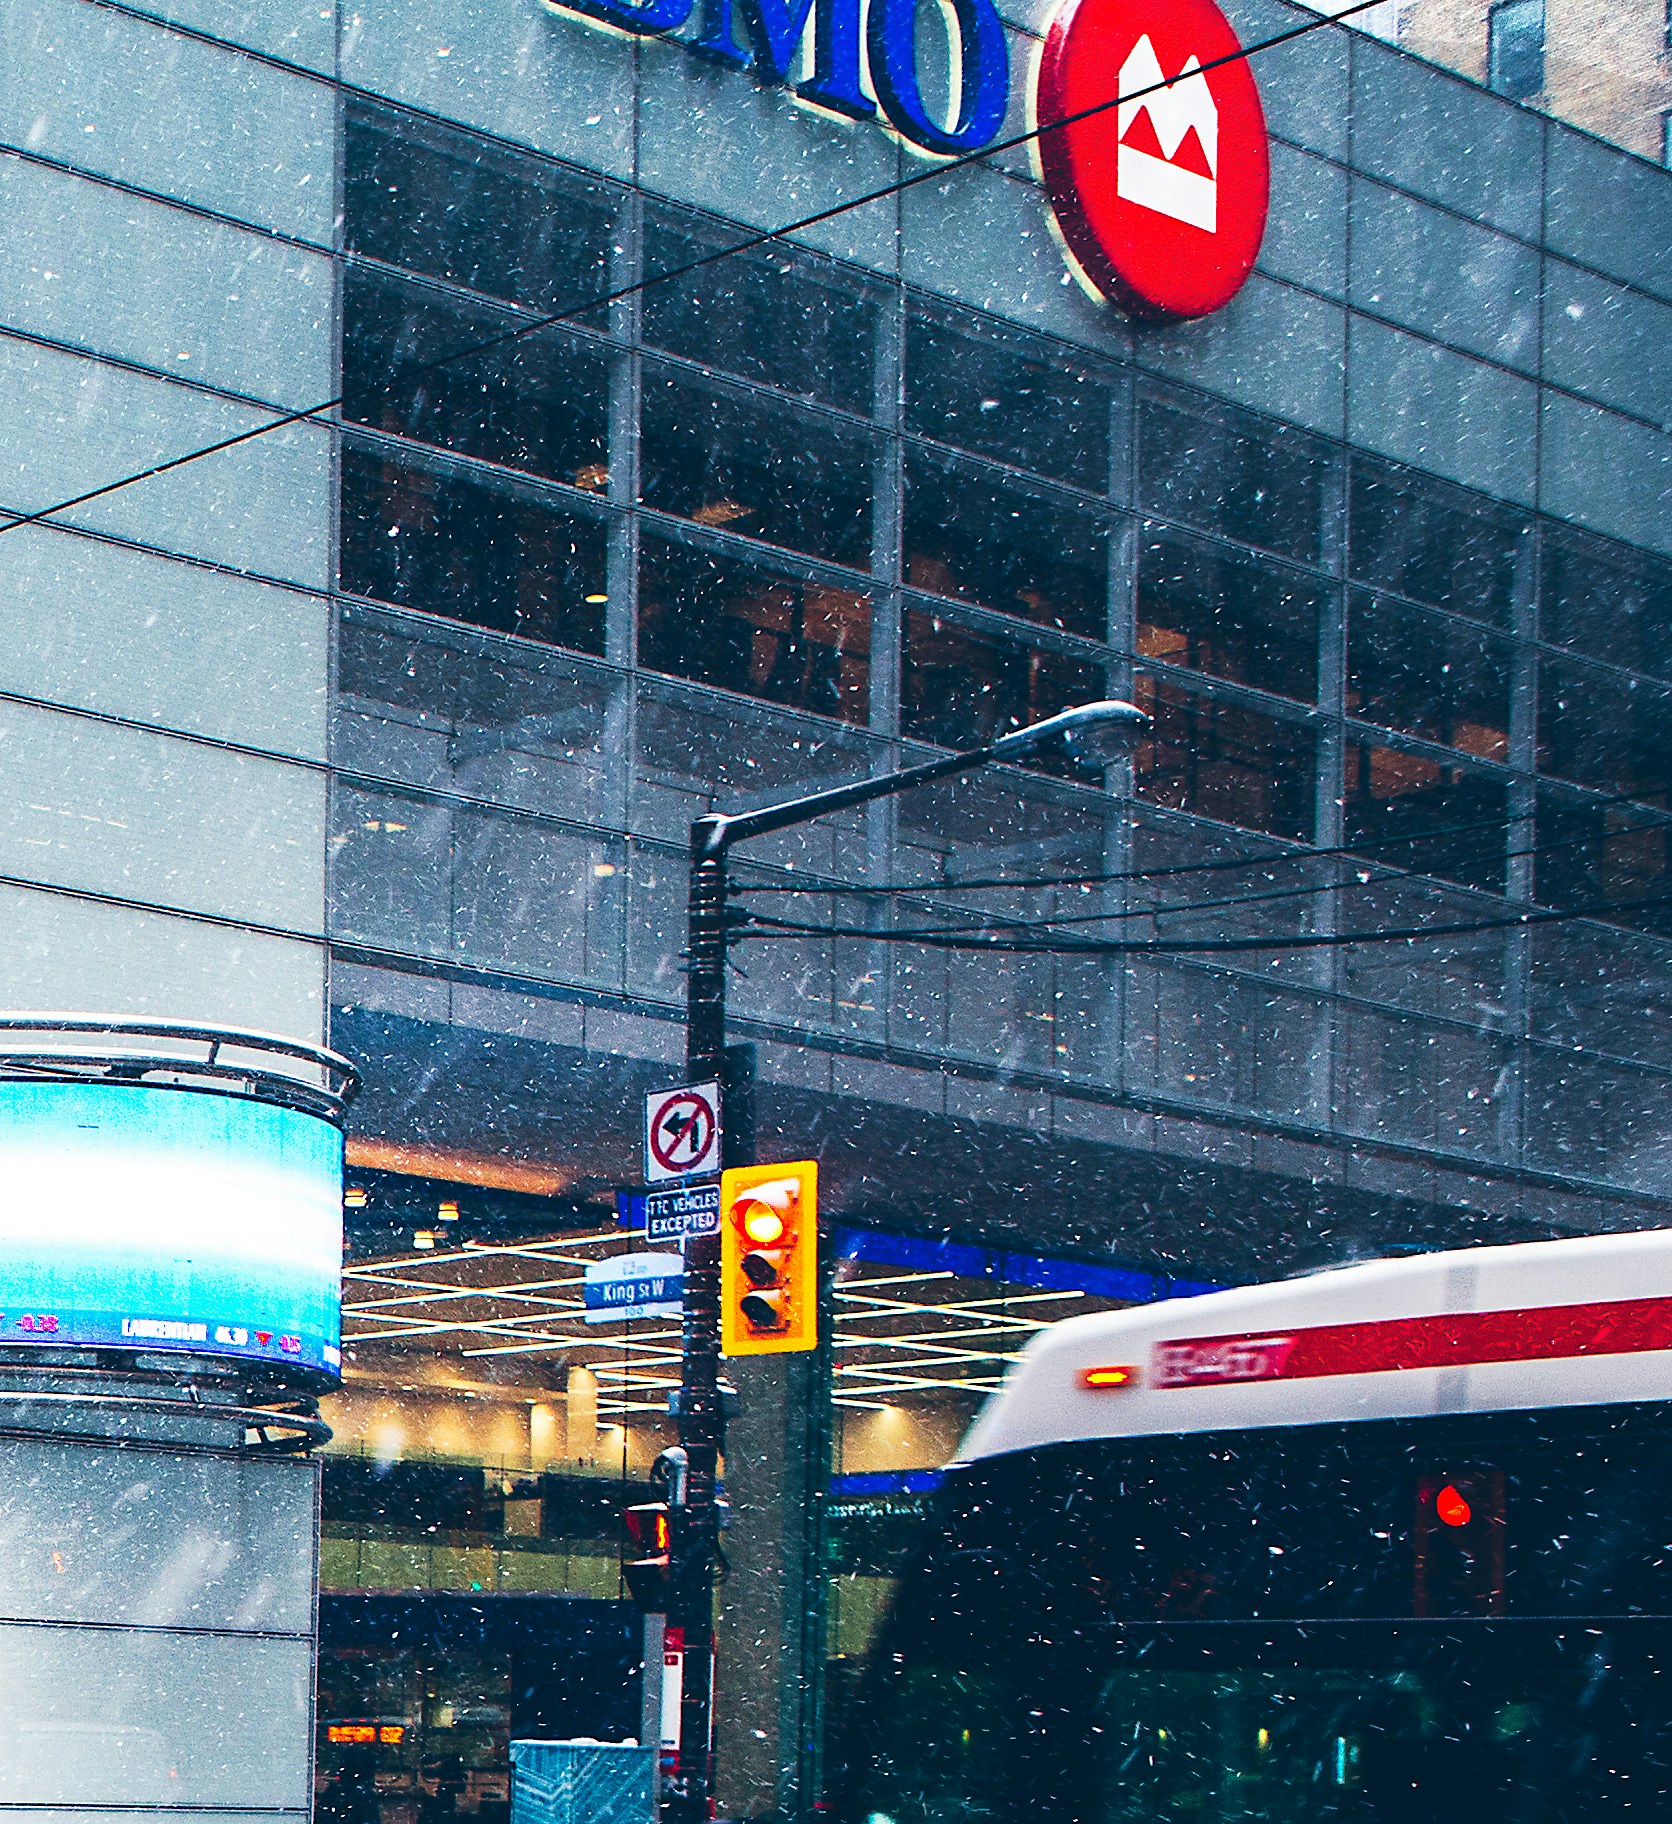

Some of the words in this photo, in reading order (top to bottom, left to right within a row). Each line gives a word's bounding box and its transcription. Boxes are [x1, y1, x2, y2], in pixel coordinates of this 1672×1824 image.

[542, 0, 1011, 154] MO
[649, 1199, 669, 1215] TTC
[672, 1192, 719, 1212] VEHICLES
[651, 1211, 716, 1235] EXCEPTED
[603, 1283, 636, 1303] King
[651, 1278, 665, 1296] W
